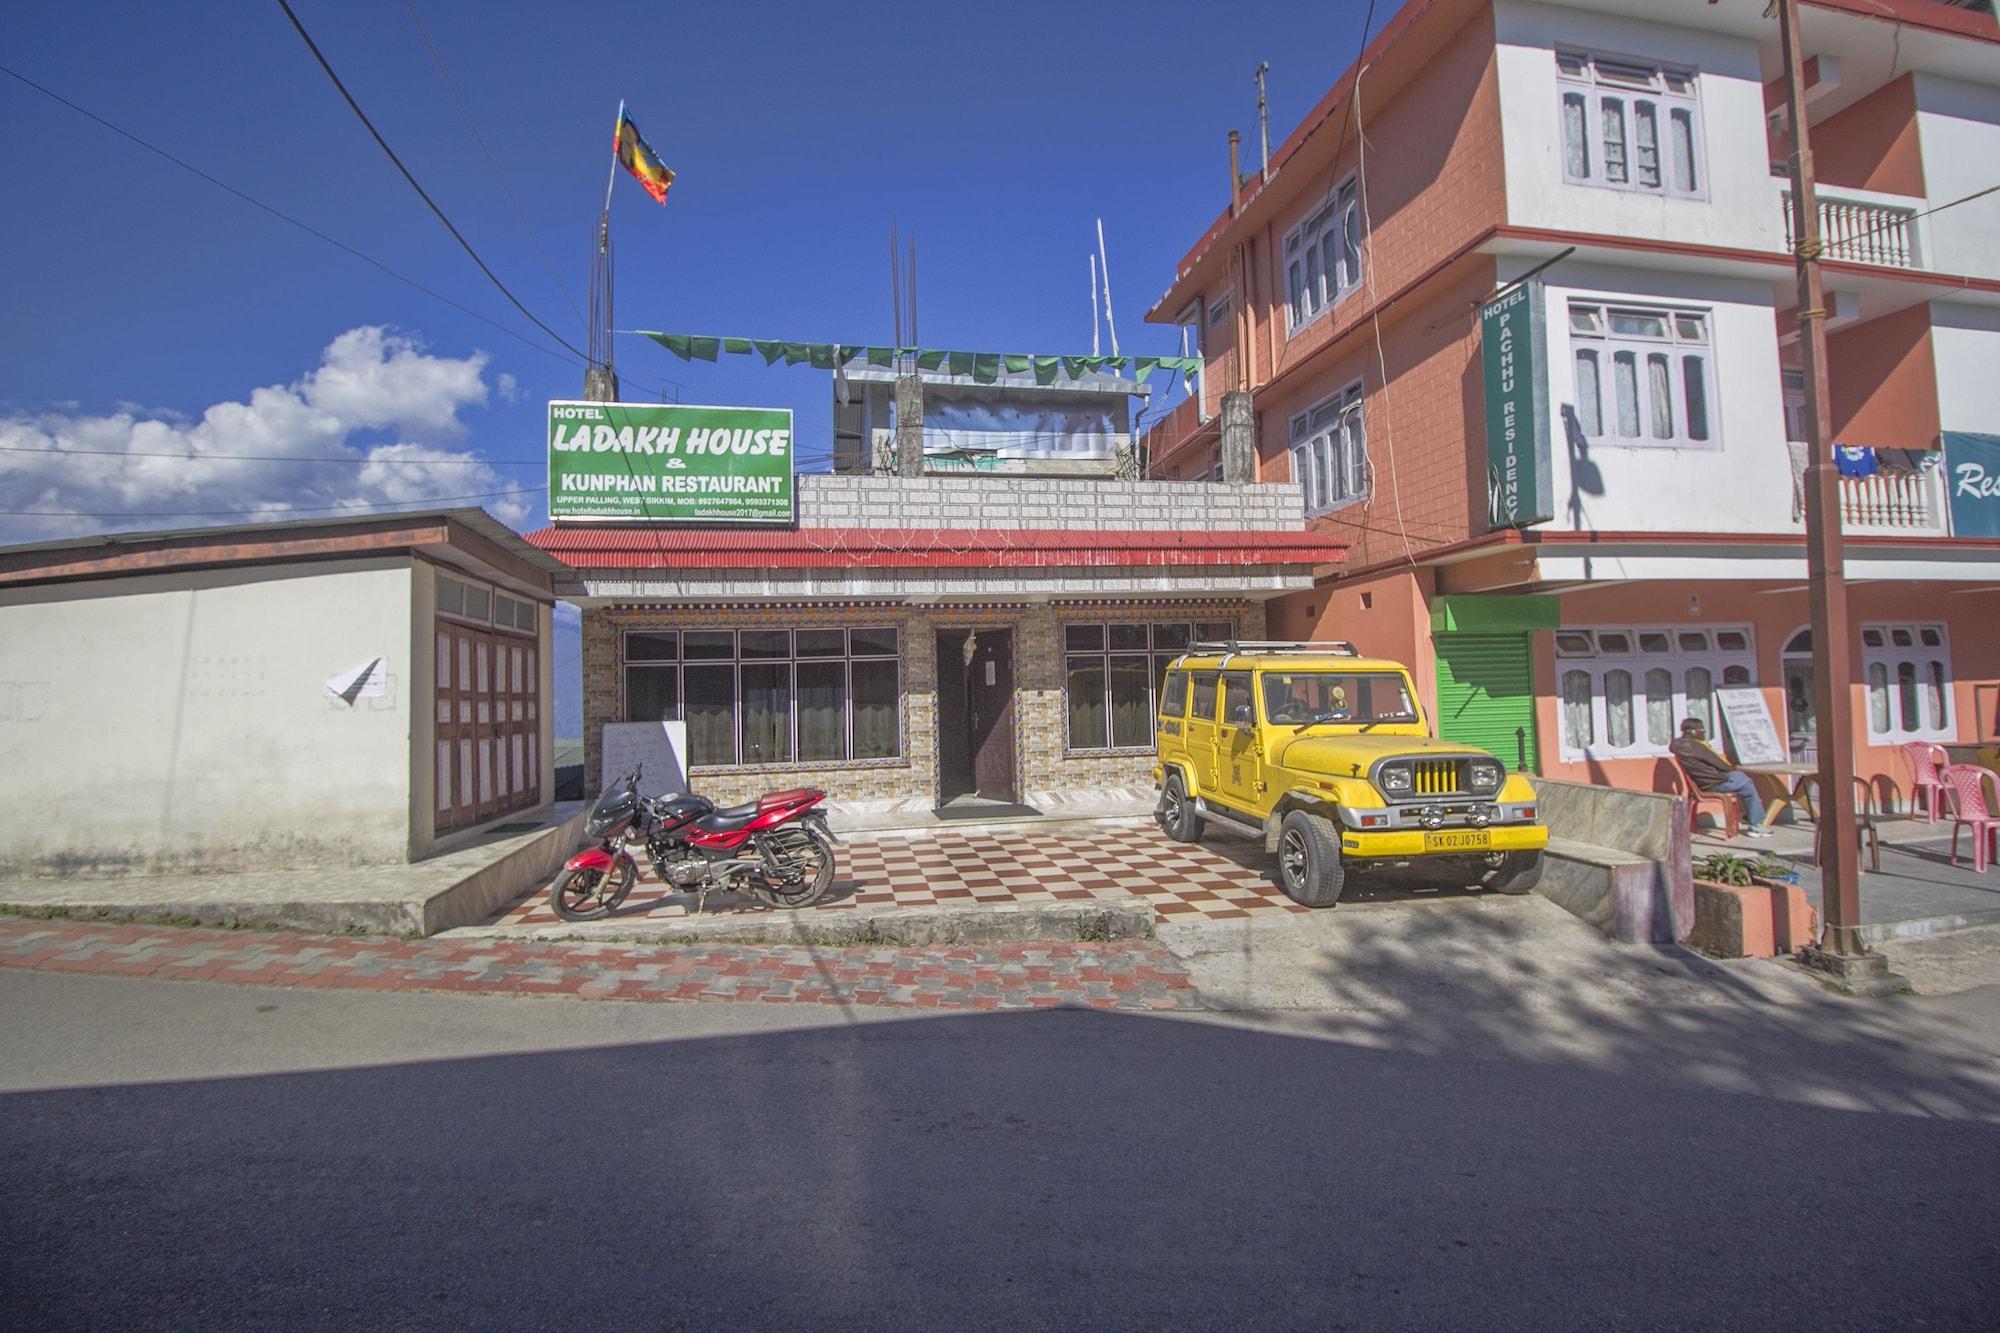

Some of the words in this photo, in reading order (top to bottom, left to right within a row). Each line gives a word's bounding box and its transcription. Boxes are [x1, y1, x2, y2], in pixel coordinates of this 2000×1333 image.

[1483, 291, 1526, 320] HOTEL
[1500, 312, 1515, 393] PACHHU
[554, 407, 604, 420] HOTEL
[553, 424, 681, 456] LADAKH
[686, 427, 790, 456] HOUSE
[666, 457, 687, 469] &
[1503, 401, 1518, 521] RESIDENCY
[561, 473, 656, 492] KUNPHAN
[661, 475, 783, 494] RESTAURANT
[557, 496, 584, 504] UPPER
[585, 496, 621, 506] PALLING,
[677, 498, 696, 506] MOB:
[1433, 836, 1444, 847] SK
[1446, 835, 1457, 847] 02
